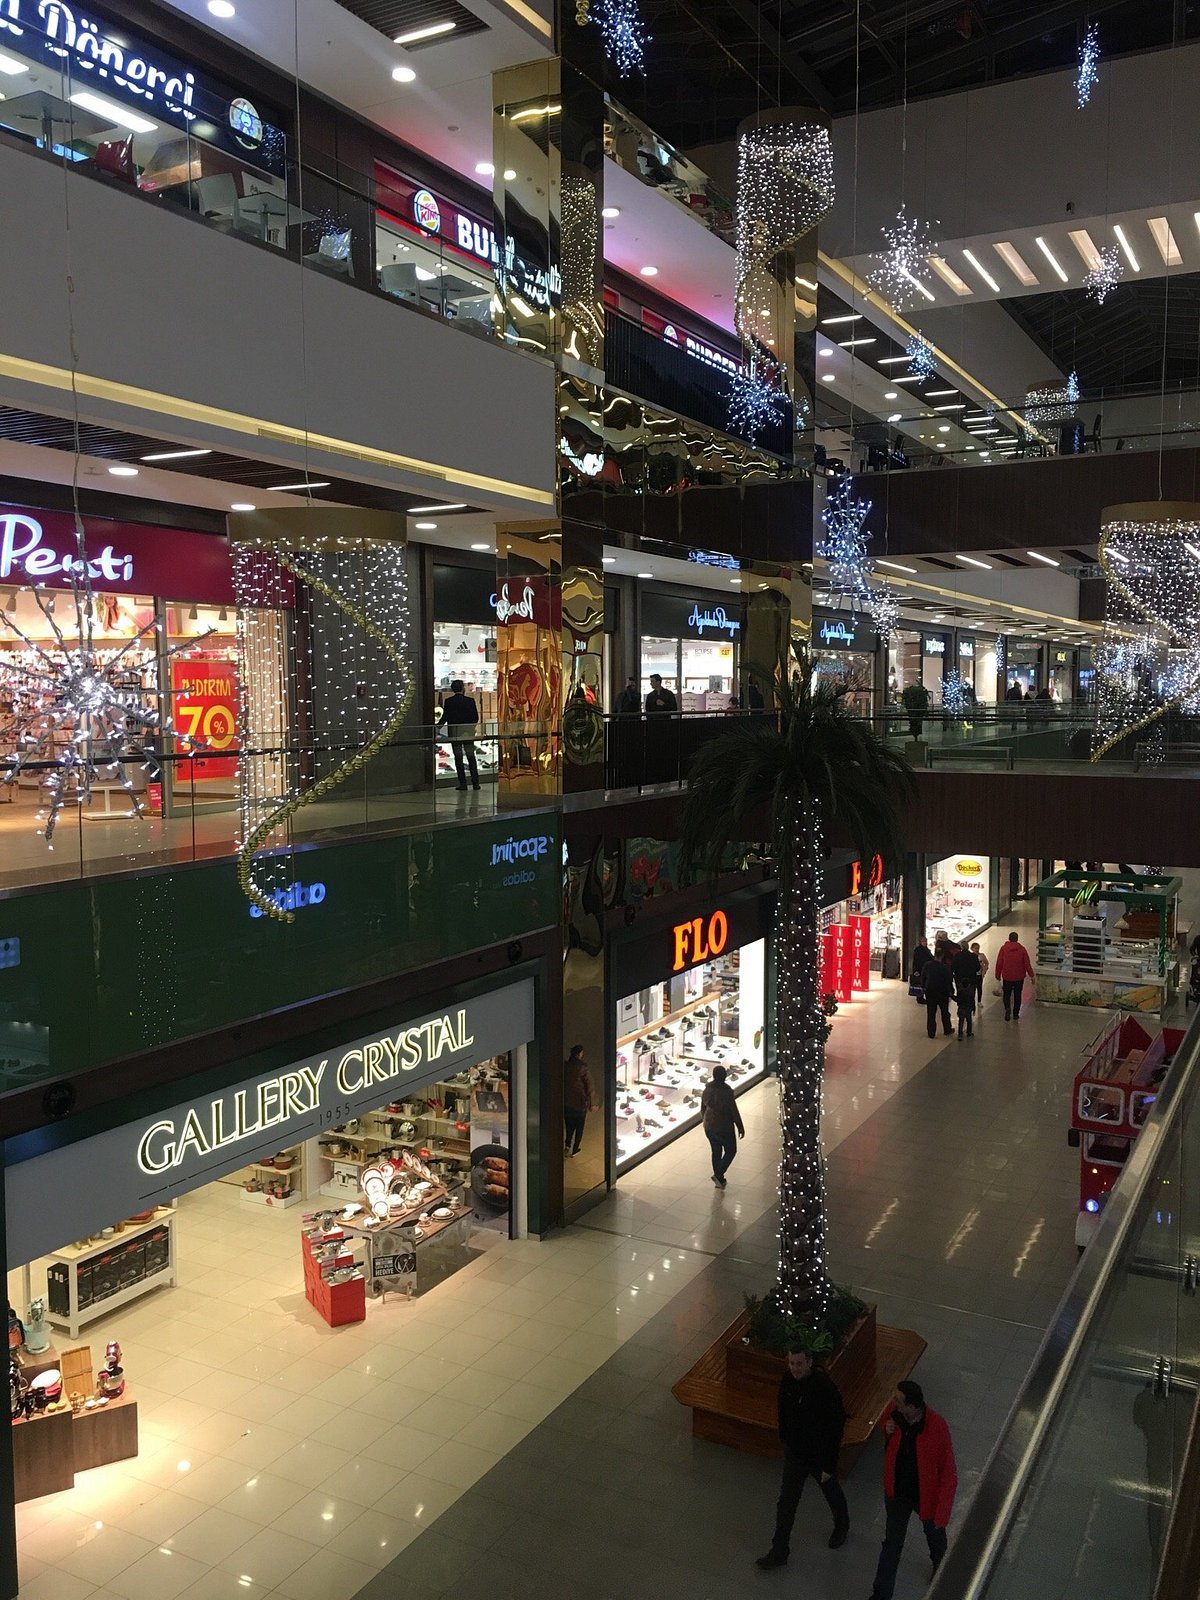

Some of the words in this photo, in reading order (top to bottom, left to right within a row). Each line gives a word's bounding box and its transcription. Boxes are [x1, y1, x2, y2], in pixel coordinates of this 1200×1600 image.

[38, 0, 197, 120] Dönerci
[0, 514, 133, 580] Penti
[852, 854, 882, 895] FO
[953, 880, 985, 889] Polaris
[673, 910, 728, 971] FLO
[136, 1060, 328, 1176] GALLERY
[336, 1009, 474, 1095] CRYSTAL
[320, 1102, 350, 1126] 1955
